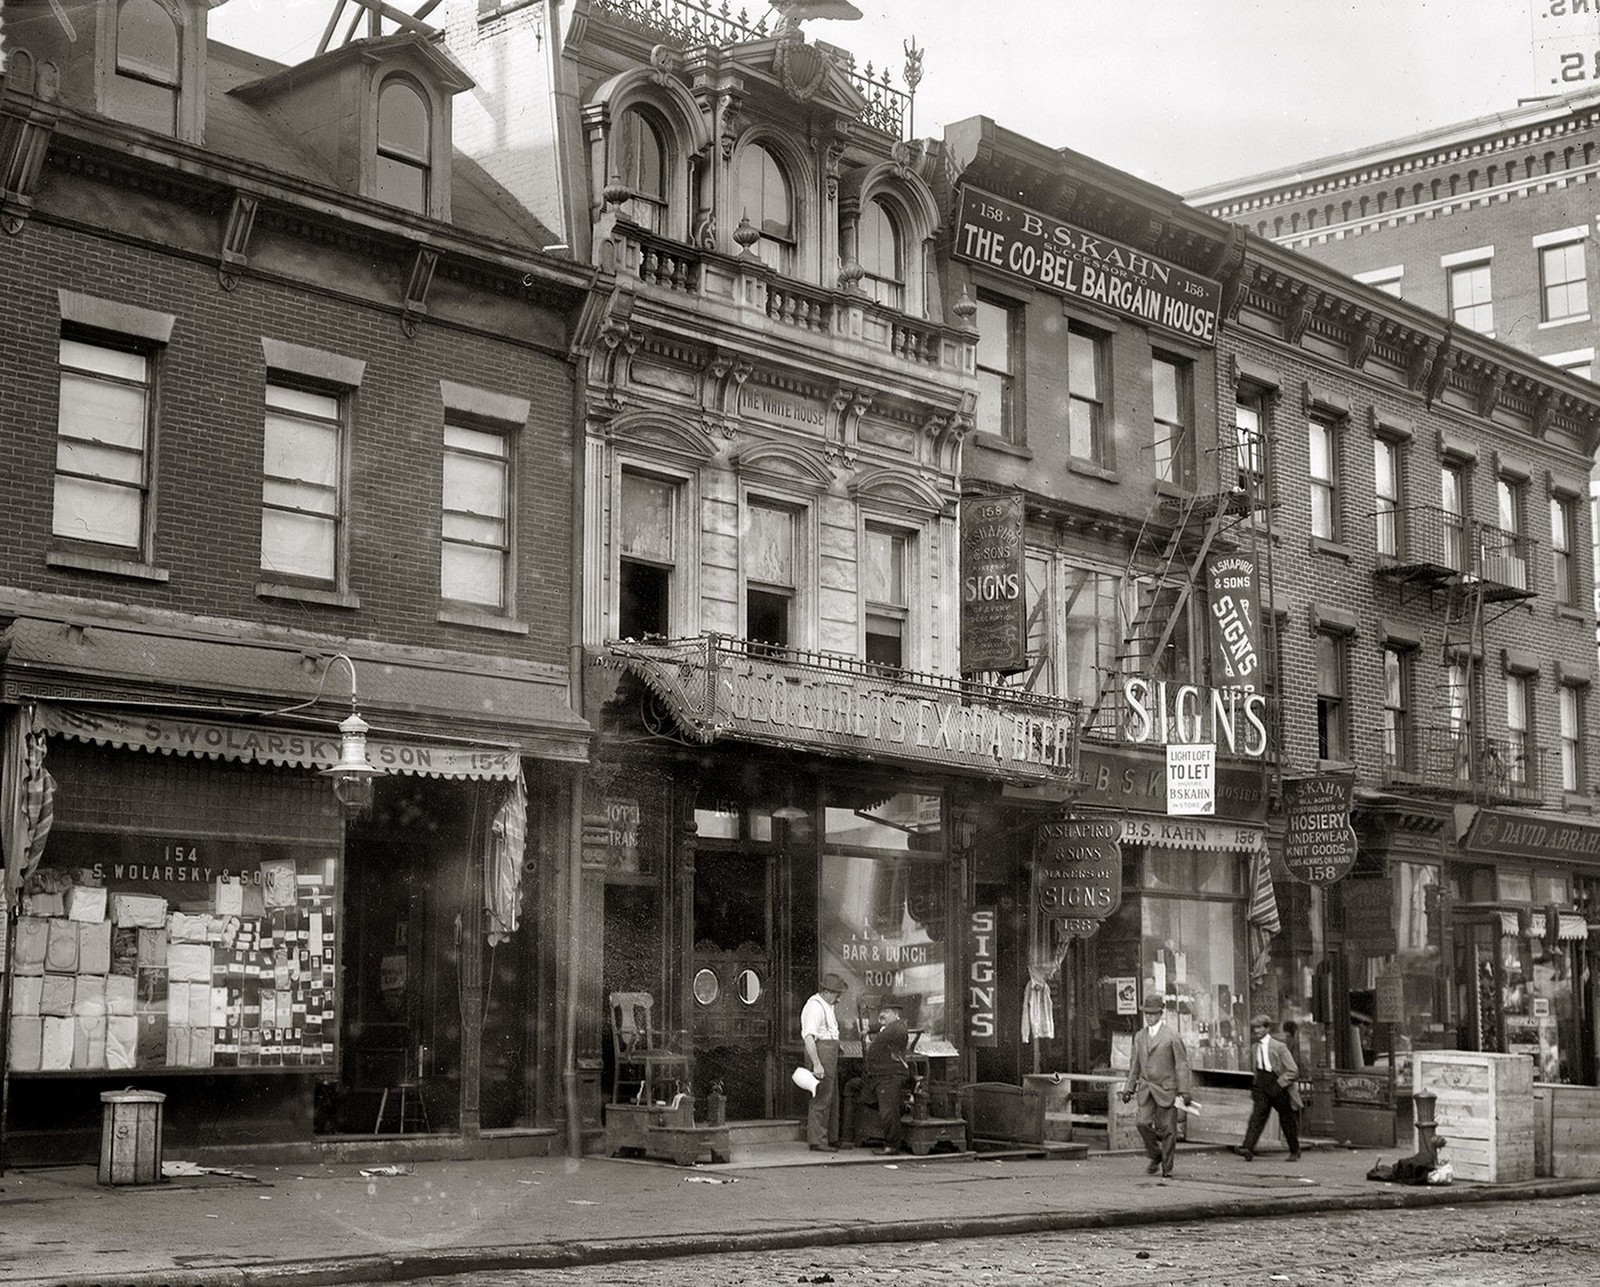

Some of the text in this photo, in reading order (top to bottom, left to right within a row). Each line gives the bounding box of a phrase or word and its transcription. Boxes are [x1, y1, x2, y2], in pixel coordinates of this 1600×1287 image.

[980, 203, 1003, 222] 158
[1044, 241, 1147, 286] SUCCESSOR TO
[964, 223, 1005, 266] THE
[1081, 265, 1161, 321] BARGAIN
[1163, 296, 1214, 340] HOUSE
[1184, 281, 1204, 298] 158
[742, 390, 824, 426] THE WHITE HOUSE
[982, 506, 1002, 518] 158
[983, 546, 1011, 560] SONS
[965, 573, 1020, 600] SIGNS
[1214, 576, 1251, 590] & SONS
[1212, 595, 1258, 676] SIGNS
[1124, 679, 1267, 757] SIGNS
[380, 747, 433, 768] SON
[1171, 750, 1211, 762] LIGHT LOFT
[1170, 763, 1211, 780] TO LET
[1290, 812, 1346, 831] HOSIERY
[1161, 825, 1207, 842] KAHN
[1235, 830, 1256, 845] 158
[1288, 830, 1350, 844] UNDERWEAR
[1499, 821, 1547, 847] DAVID
[164, 846, 198, 863] 154
[1067, 847, 1102, 860] SONS
[1286, 846, 1309, 857] KNIT
[1311, 843, 1346, 855] GOODS
[221, 868, 231, 885] &
[240, 870, 275, 888] SON
[1044, 869, 1113, 879] MAKERS OF
[1308, 865, 1336, 881] 158
[1044, 887, 1112, 907] SIGNS
[843, 944, 927, 963] BAR & LUNCH
[865, 970, 908, 987] ROOM.
[969, 911, 995, 1037] SIGNS
